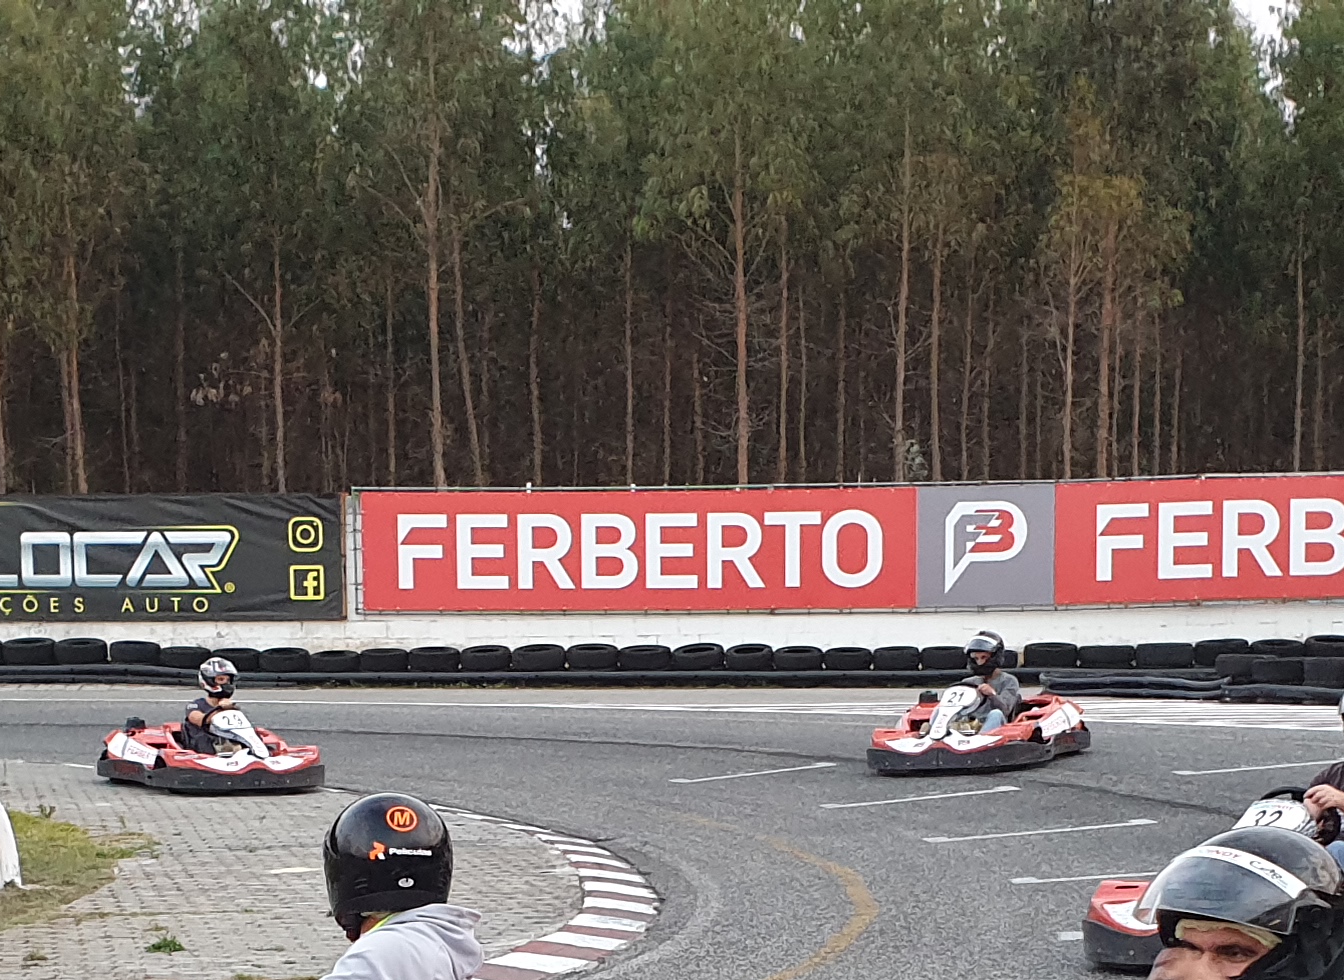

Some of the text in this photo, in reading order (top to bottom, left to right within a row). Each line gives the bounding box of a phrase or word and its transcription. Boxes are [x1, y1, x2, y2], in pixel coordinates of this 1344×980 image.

[396, 509, 884, 590] FERBERTO
[122, 596, 209, 612] AUTO
[947, 691, 965, 704] 21
[393, 811, 411, 826] M
